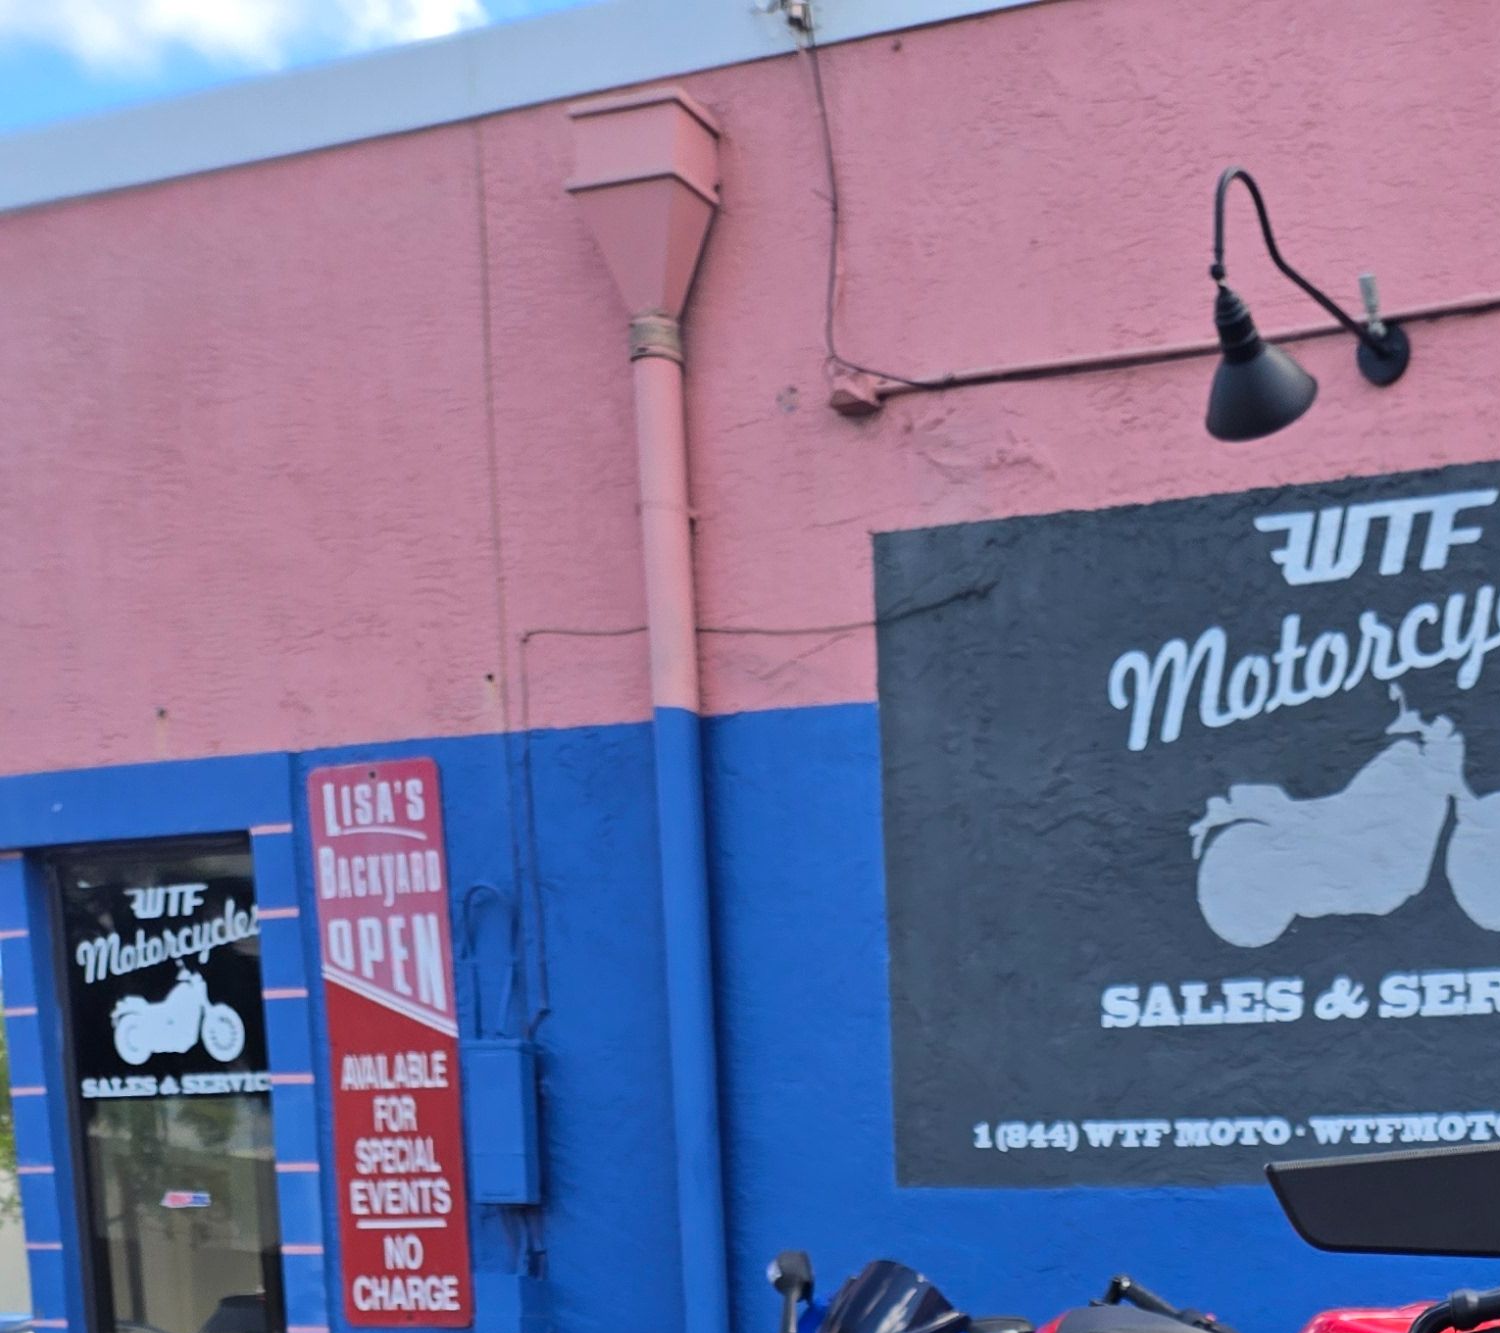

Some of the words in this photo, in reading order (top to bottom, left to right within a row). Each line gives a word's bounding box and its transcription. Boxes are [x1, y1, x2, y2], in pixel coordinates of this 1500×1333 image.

[1253, 489, 1499, 586] WTF
[123, 883, 208, 919] WTF
[327, 912, 447, 1012] OPEN
[1101, 977, 1302, 1029] SALES
[1313, 978, 1370, 1020] &
[82, 1075, 157, 1098] SALES
[181, 1071, 273, 1095] SERVIC
[341, 1050, 449, 1091] AVAILABLE
[372, 1094, 418, 1133] FOR
[996, 1121, 1079, 1152] (844)
[1081, 1120, 1169, 1148] WTF
[1174, 1117, 1290, 1147] MOTO
[355, 1136, 443, 1175] SPECIAL
[349, 1178, 453, 1216] EVENTS
[383, 1233, 424, 1271] NO
[352, 1275, 461, 1312] CHARGE
